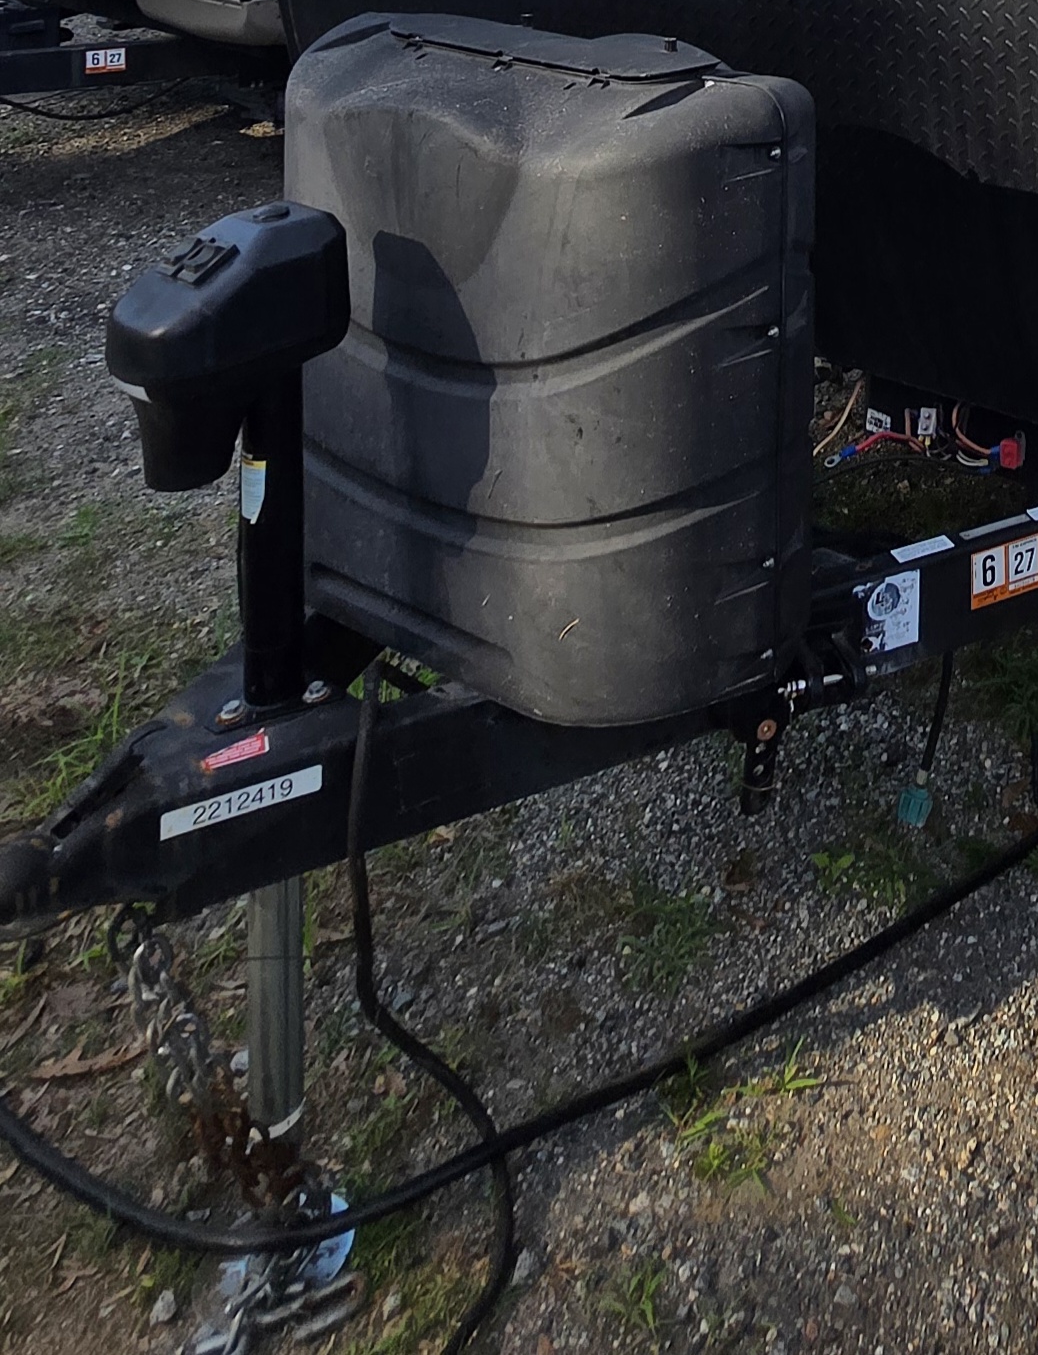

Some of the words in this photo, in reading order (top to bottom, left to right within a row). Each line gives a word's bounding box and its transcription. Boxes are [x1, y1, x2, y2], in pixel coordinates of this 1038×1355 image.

[91, 52, 100, 66] 6
[109, 52, 122, 64] 27
[982, 554, 996, 587] 6
[1014, 547, 1035, 576] 27
[192, 778, 293, 826] 2212419
